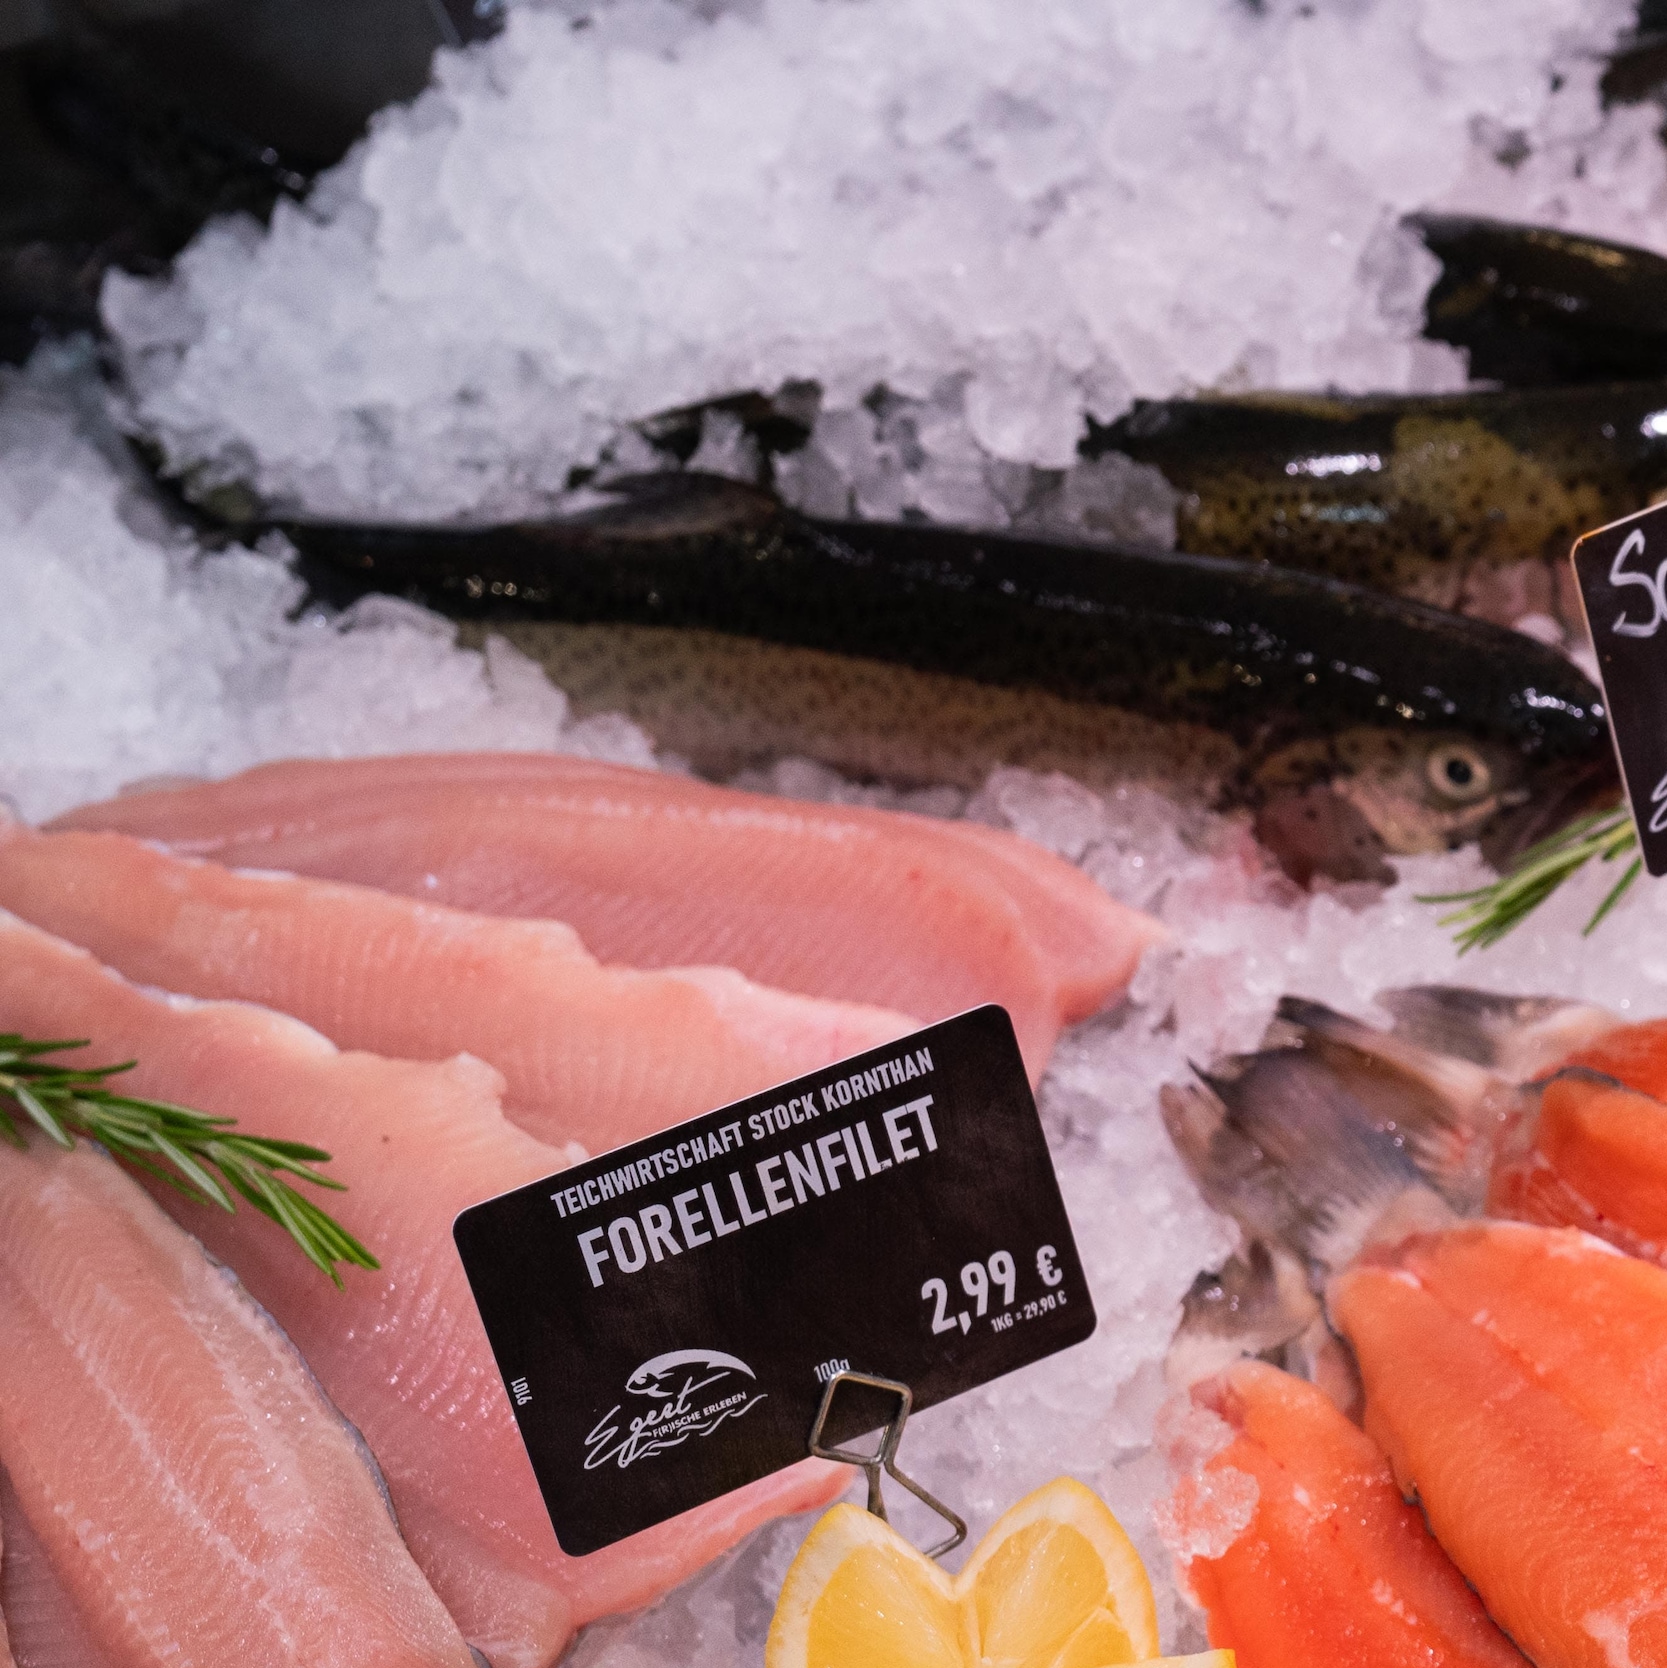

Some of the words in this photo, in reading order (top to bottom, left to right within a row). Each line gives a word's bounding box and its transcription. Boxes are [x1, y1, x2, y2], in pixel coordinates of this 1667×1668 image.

[550, 1121, 744, 1219] TEICHWIRTSCHAFT
[748, 1092, 820, 1142] STOCK
[821, 1047, 935, 1111] KORNTHAN
[577, 1095, 940, 1288] FORELLENFILET
[921, 1250, 1017, 1336] 2,99
[1036, 1244, 1063, 1286] €
[991, 1311, 1014, 1333] 1KG
[1023, 1294, 1057, 1320] 29,90
[511, 1376, 533, 1407] 1016
[652, 1411, 701, 1439] F(R)ISCHE
[704, 1391, 748, 1418] ERLEBEN
